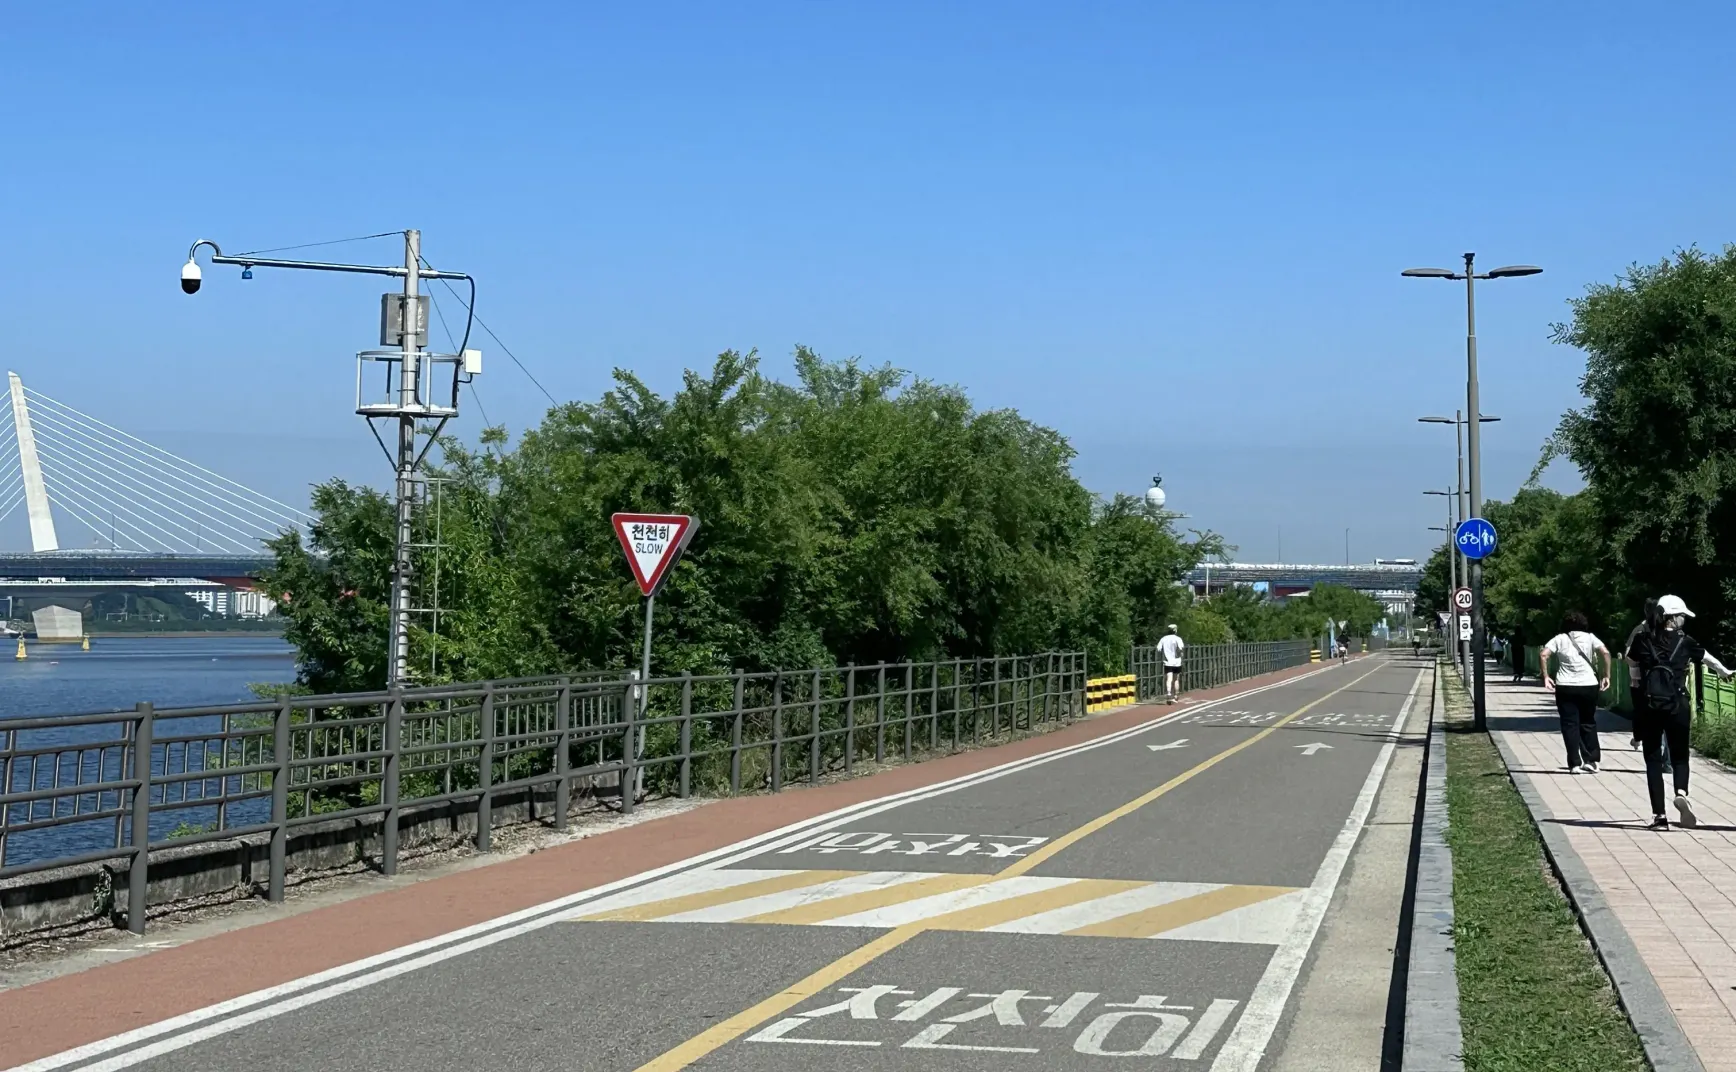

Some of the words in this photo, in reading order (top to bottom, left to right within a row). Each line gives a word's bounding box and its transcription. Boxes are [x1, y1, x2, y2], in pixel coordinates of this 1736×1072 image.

[632, 524, 670, 542] 천천히
[635, 542, 664, 554] SLOW
[1458, 593, 1471, 604] 20
[743, 985, 1239, 1060] 천천히
